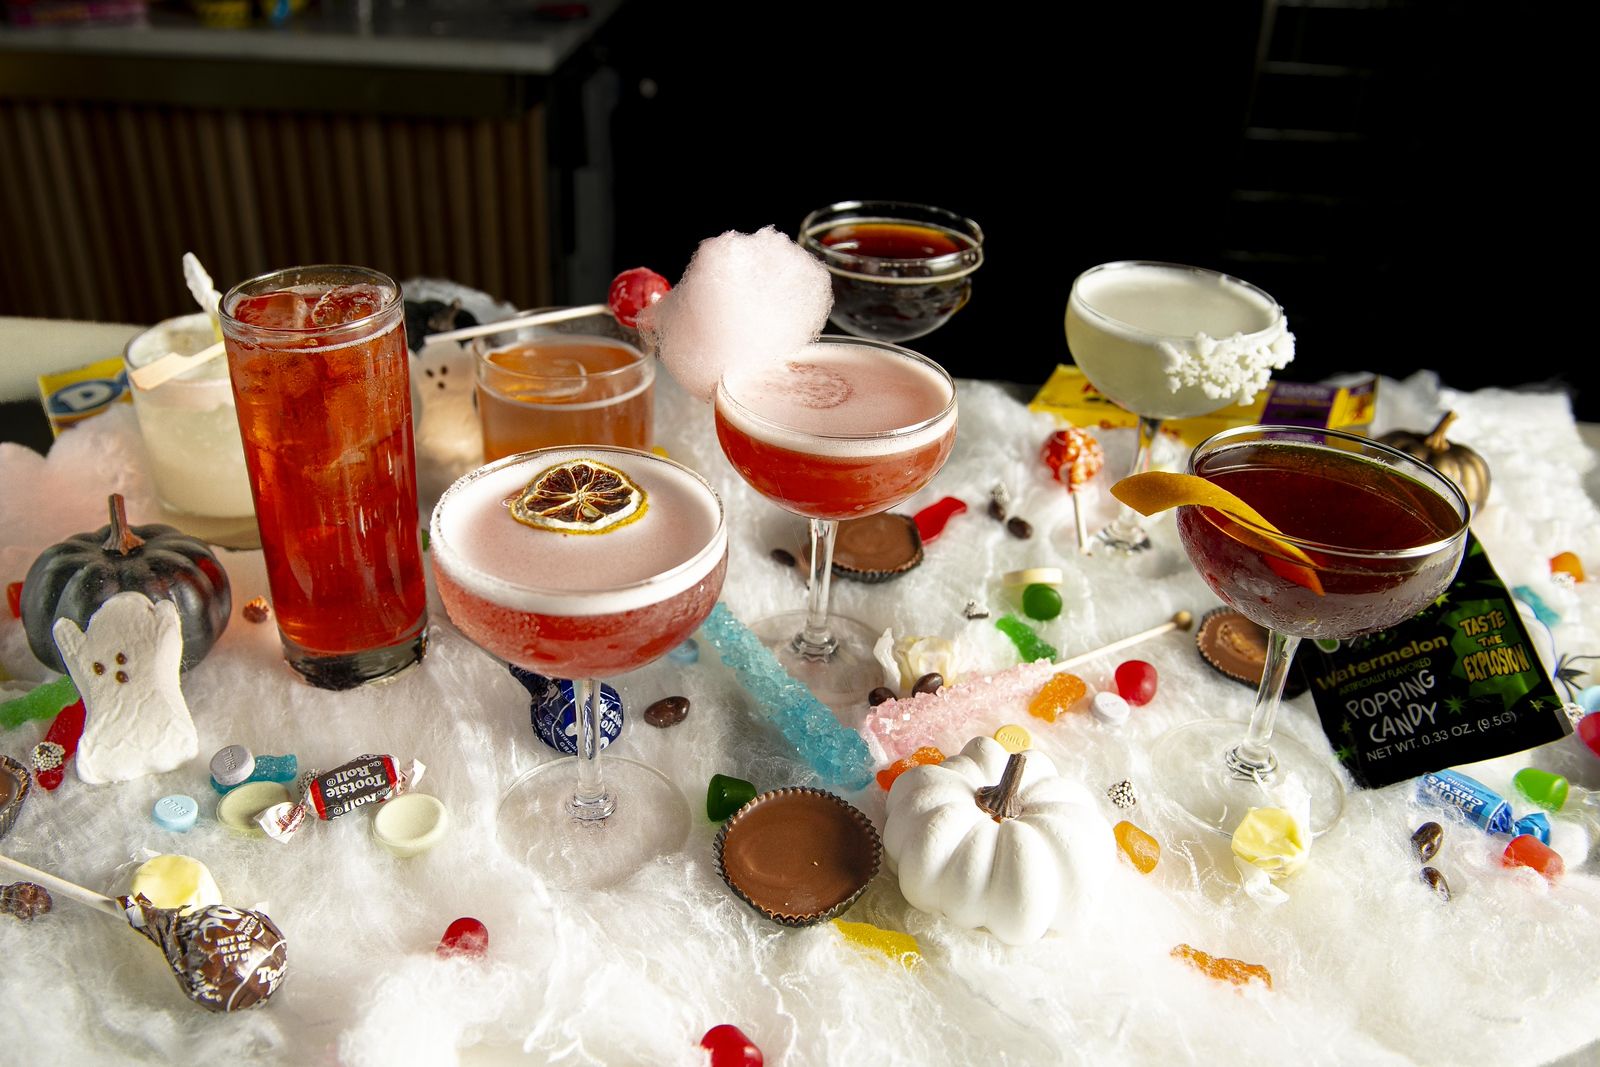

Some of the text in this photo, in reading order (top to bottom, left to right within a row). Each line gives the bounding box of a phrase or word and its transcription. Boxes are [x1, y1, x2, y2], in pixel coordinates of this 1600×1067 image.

[1459, 608, 1506, 637] TASTE
[1477, 634, 1503, 647] THE
[1316, 635, 1449, 690] Watermelon
[1387, 656, 1432, 679] FLAVORED
[1463, 643, 1530, 683] EXPLOSION
[1345, 669, 1435, 719] POPPING
[1366, 711, 1517, 762] NET WT. 0.33 OZ. (9.5G)
[1369, 701, 1437, 743] CANDY
[325, 774, 387, 799] Tootsie
[1427, 775, 1485, 806] CHEWS
[163, 798, 190, 816] BOLD
[217, 936, 236, 947] NET
